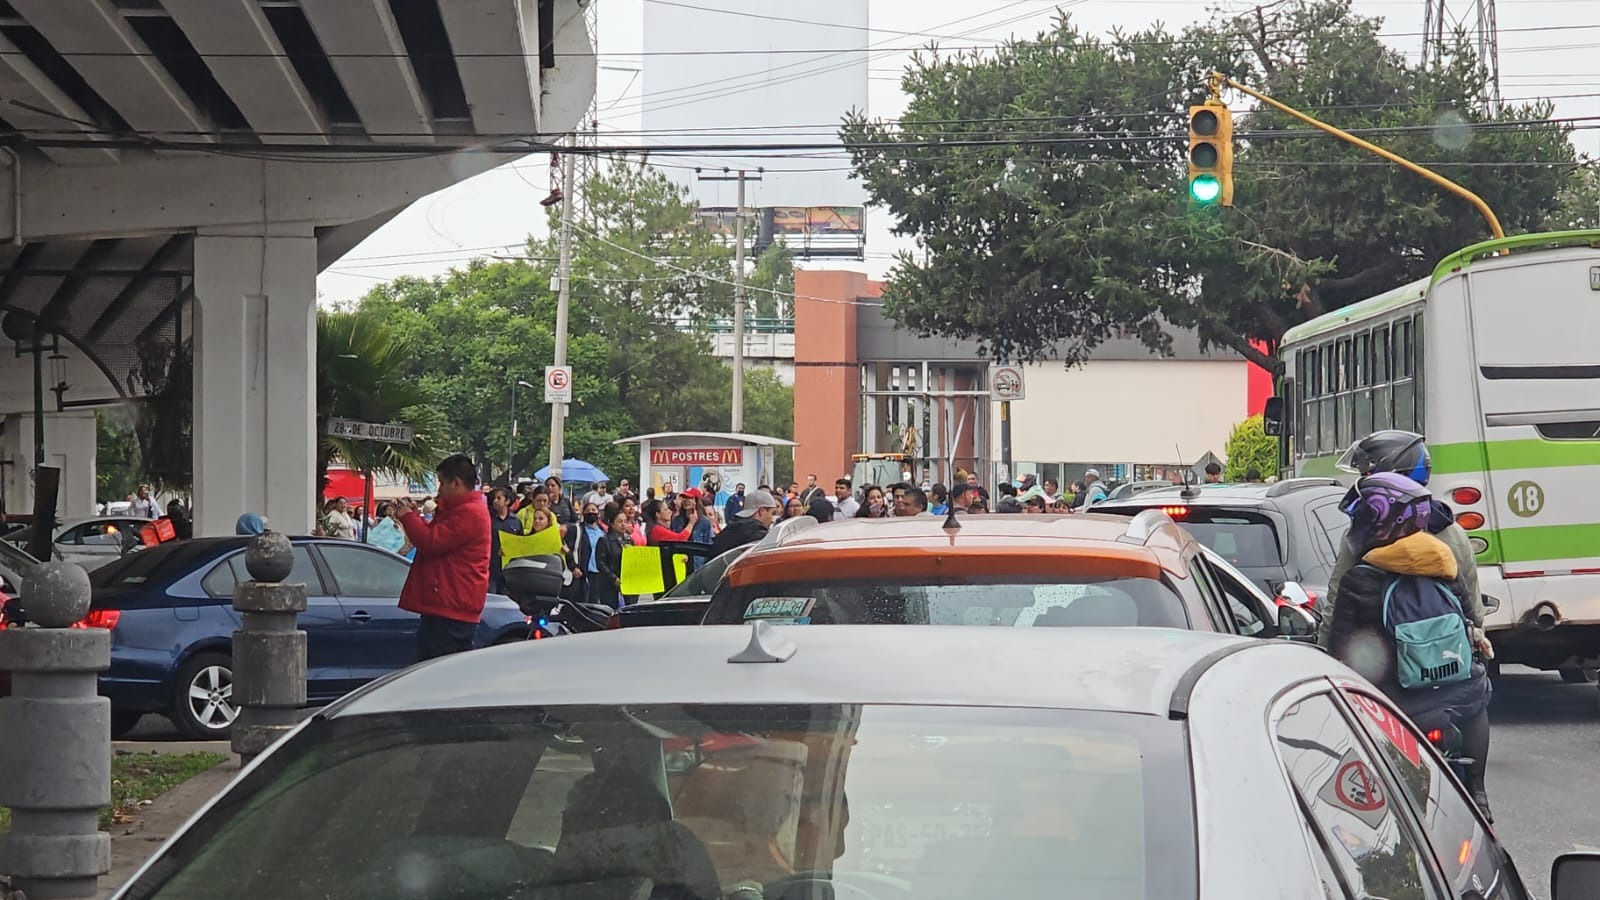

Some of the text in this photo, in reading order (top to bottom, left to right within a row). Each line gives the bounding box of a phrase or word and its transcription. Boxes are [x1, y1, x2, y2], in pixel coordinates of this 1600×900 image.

[334, 422, 406, 439] 28 DE OCTUBRE
[672, 452, 719, 461] POSTRES
[1514, 486, 1539, 512] 18
[1420, 661, 1459, 681] PUMA
